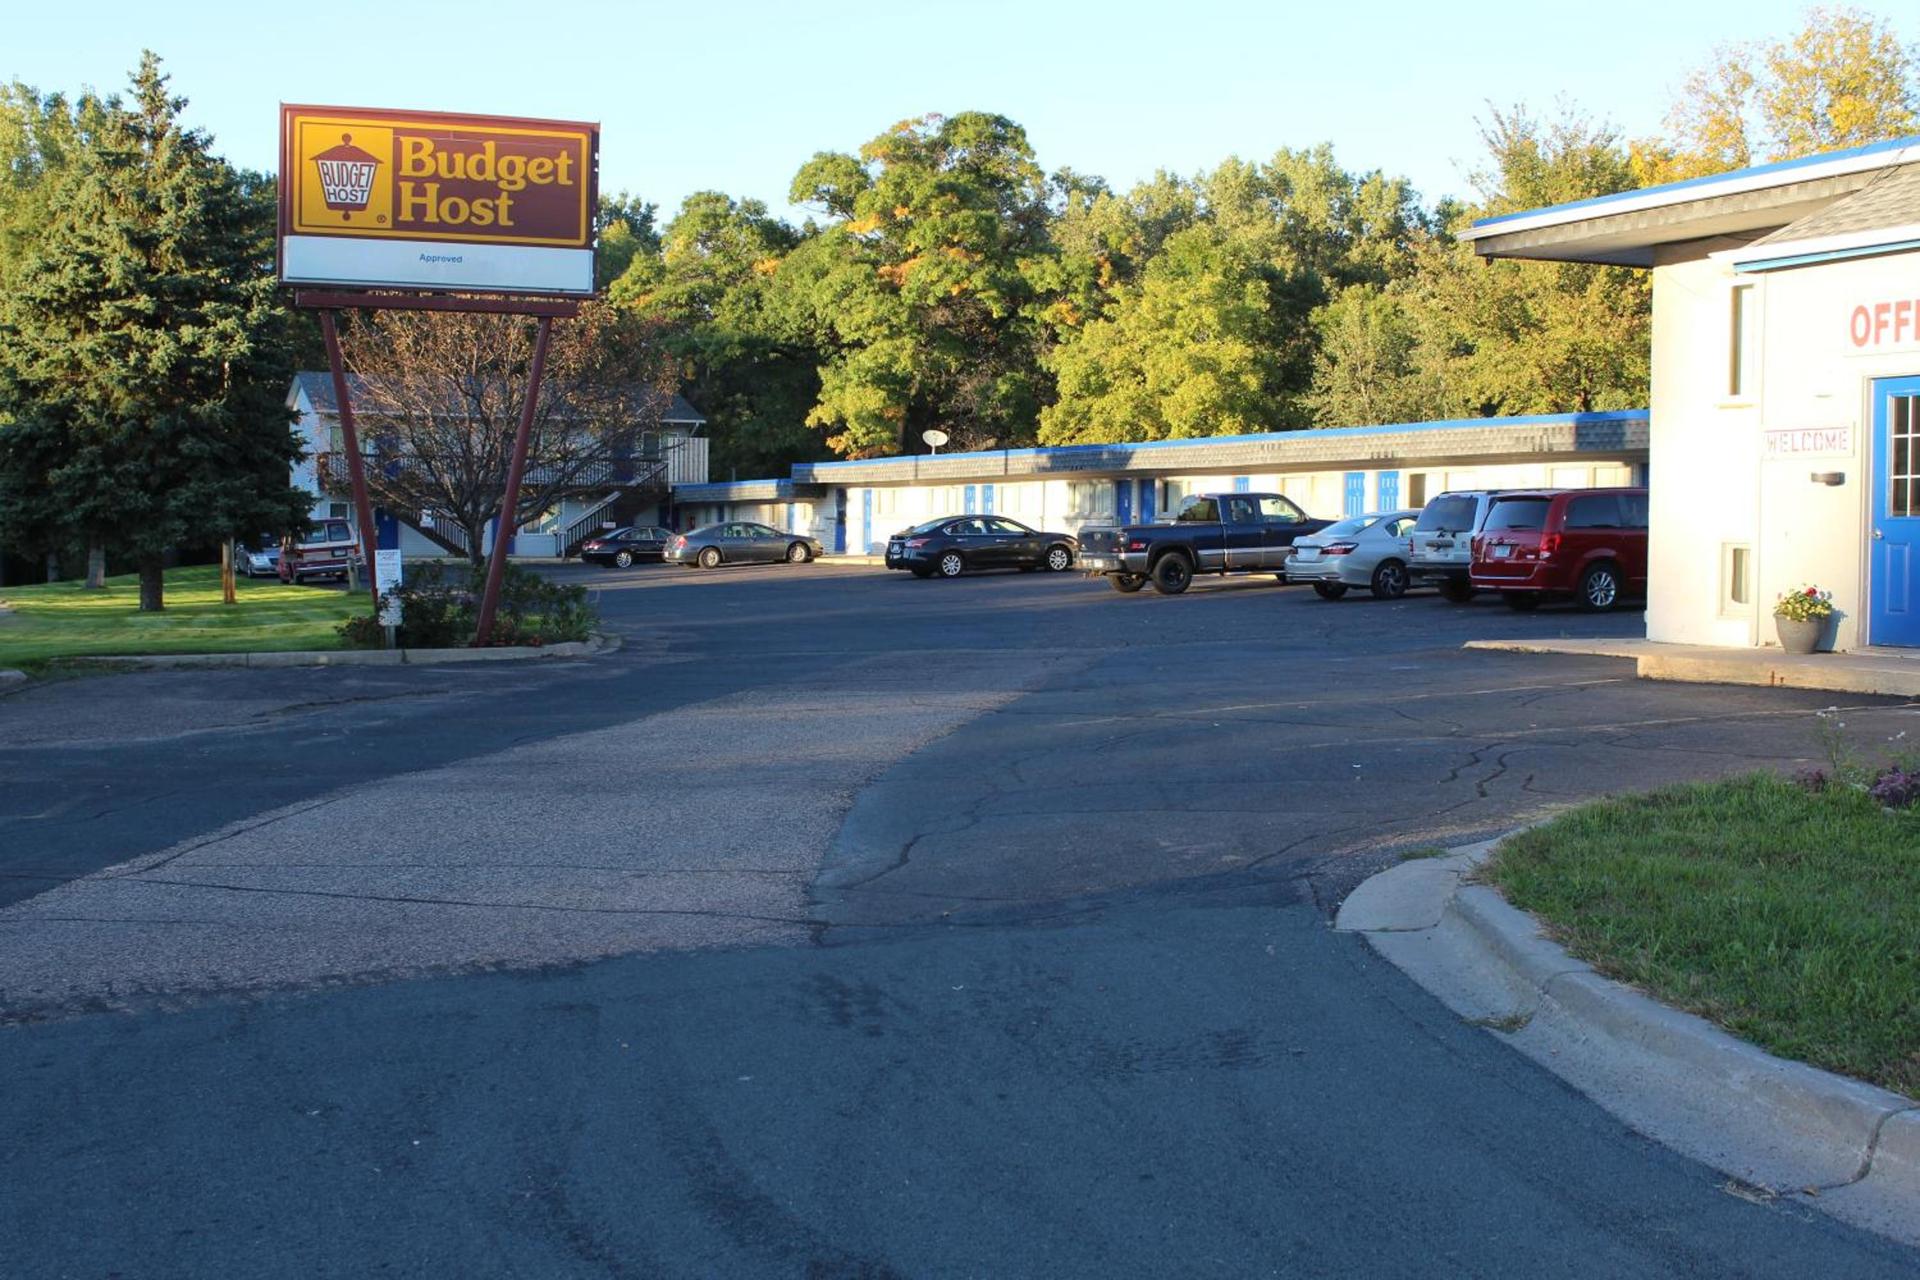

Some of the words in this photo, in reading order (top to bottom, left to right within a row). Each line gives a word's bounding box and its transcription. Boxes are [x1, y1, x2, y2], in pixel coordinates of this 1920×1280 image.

[320, 162, 374, 188] BUDGET
[399, 136, 574, 191] Budget
[326, 188, 368, 202] HOST
[398, 181, 515, 226] Host
[419, 253, 463, 264] Approved
[1850, 299, 1920, 347] OFFI
[1763, 430, 1848, 452] WELCOME
